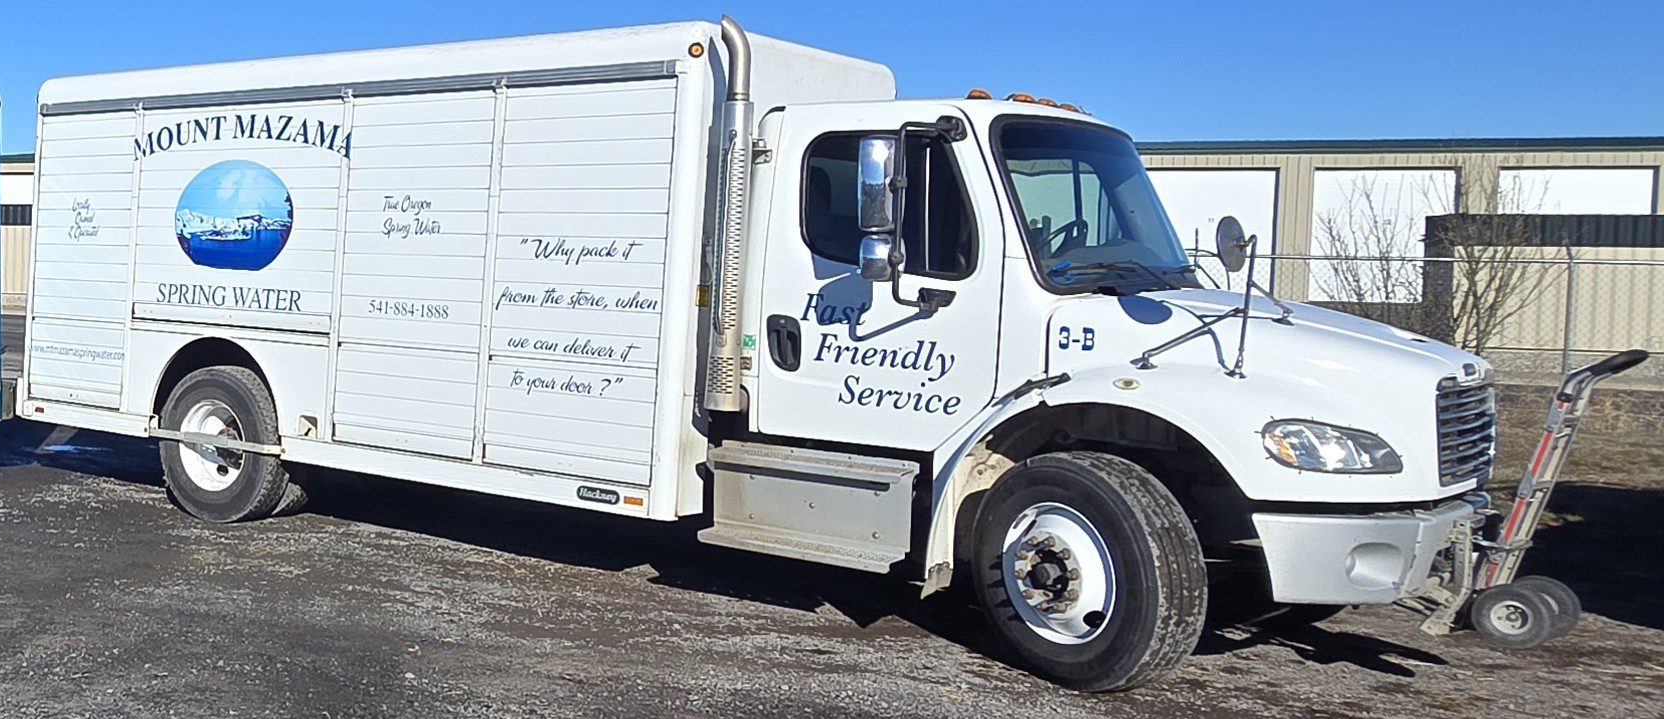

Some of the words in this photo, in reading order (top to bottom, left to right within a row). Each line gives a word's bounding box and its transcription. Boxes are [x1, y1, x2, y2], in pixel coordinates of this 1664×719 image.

[133, 115, 227, 161] MOUNT
[232, 113, 353, 161] MAZAMA
[382, 195, 399, 212] True
[400, 194, 432, 216] Oregon
[381, 217, 411, 239] Spring
[413, 217, 441, 235] Water
[575, 240, 619, 266] pack
[622, 239, 644, 261] it
[156, 282, 227, 307] SPRING
[232, 286, 302, 312] WATER
[368, 299, 449, 319] 541-884-1888
[495, 286, 539, 311] from
[540, 286, 565, 307] the
[567, 288, 609, 310] store,
[615, 291, 659, 311] when
[800, 292, 869, 326] Fast
[507, 336, 531, 349] we
[533, 339, 559, 352] can
[563, 336, 618, 359] deliver
[620, 342, 642, 363] it
[1058, 325, 1096, 351] 3-B
[813, 332, 956, 382] Friendly
[510, 367, 525, 387] to
[526, 376, 557, 396] your
[560, 374, 594, 395] door
[838, 374, 962, 416] Service
[578, 486, 618, 504] Hackney
